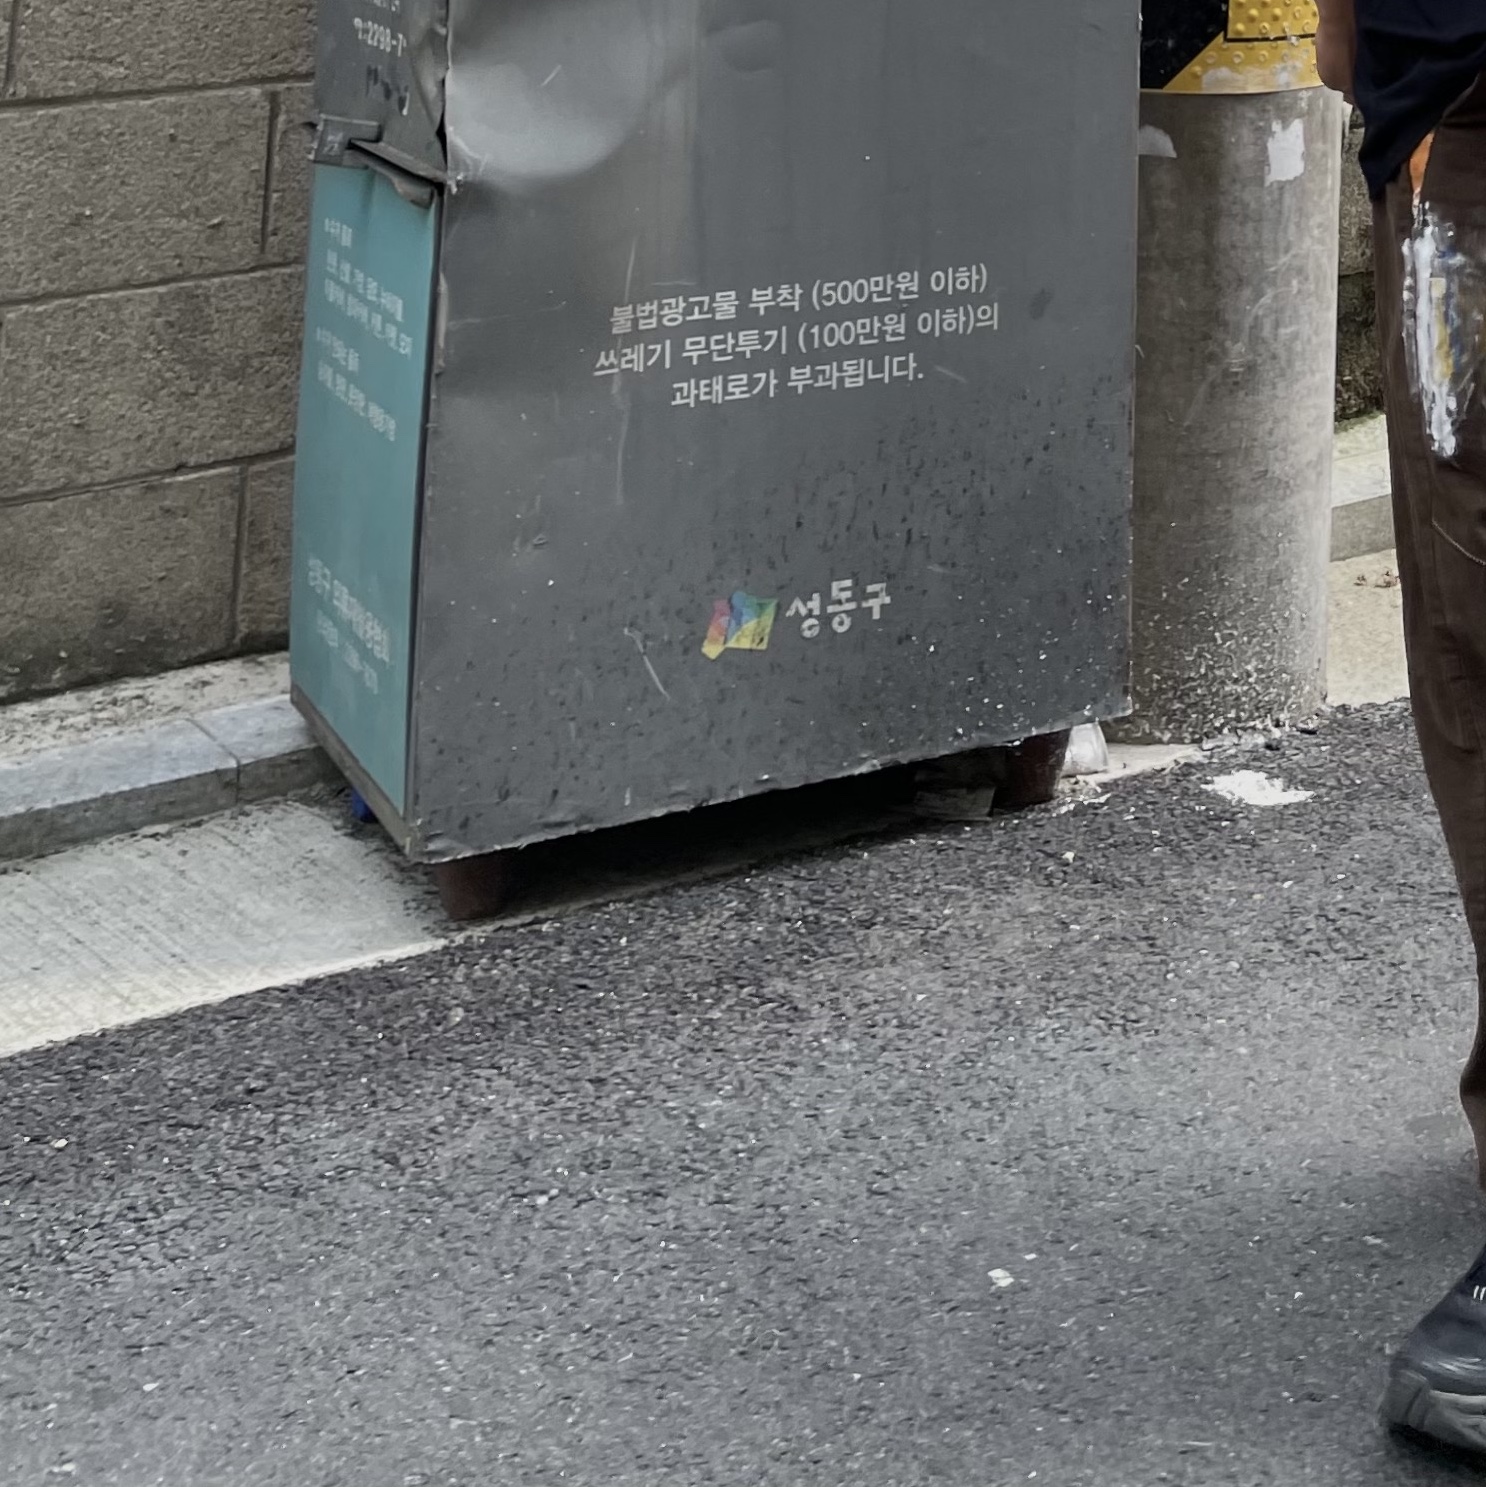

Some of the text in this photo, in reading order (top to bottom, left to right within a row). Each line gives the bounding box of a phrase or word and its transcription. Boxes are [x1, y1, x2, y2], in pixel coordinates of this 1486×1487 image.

[610, 263, 988, 335] 불법광고물 부착 (500만원 이하)
[593, 302, 998, 376] 쓰레기 무단투기 (100만원 이하)의
[787, 352, 925, 394] 부과됩니다.
[785, 579, 892, 639] 성동구
